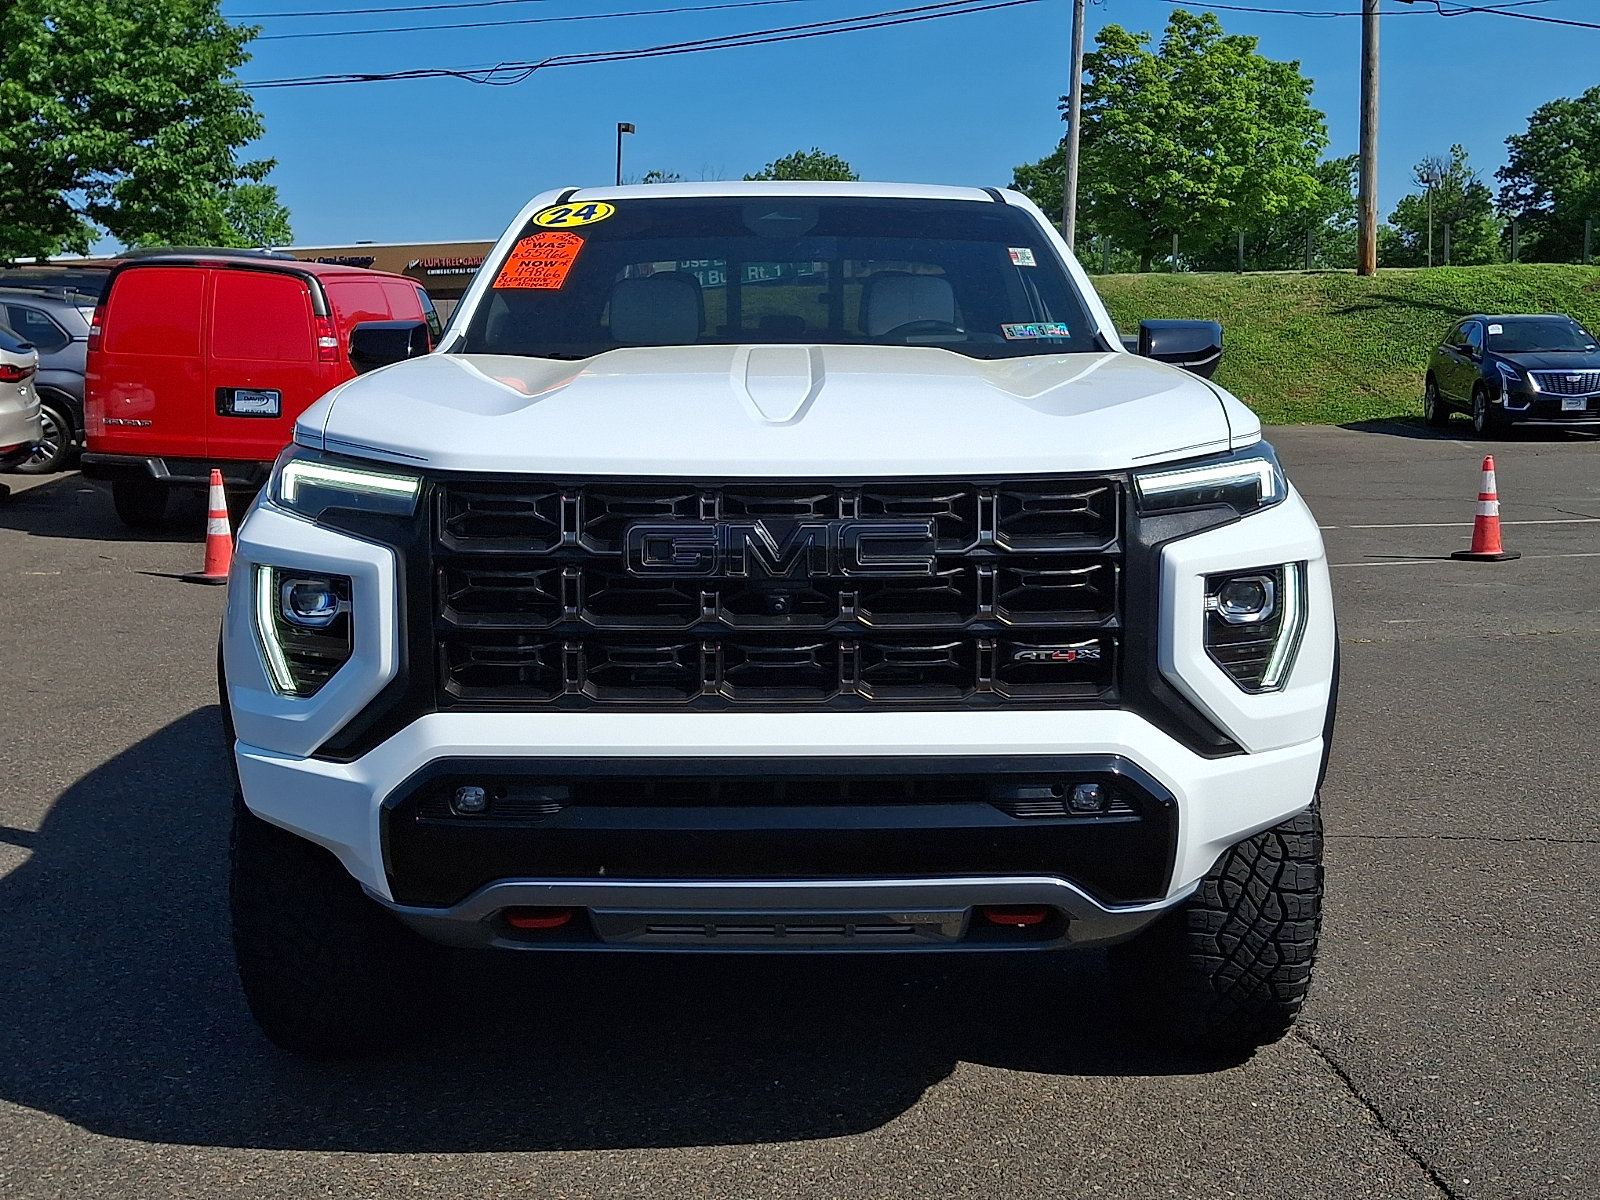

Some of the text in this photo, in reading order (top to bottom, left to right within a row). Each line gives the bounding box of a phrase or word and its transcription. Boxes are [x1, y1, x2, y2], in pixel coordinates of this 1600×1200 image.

[545, 204, 598, 225] 24
[419, 257, 440, 268] PLUM
[440, 257, 460, 267] TREE
[462, 256, 485, 266] GARD
[708, 270, 727, 284] Bu
[747, 265, 769, 280] Rt.
[623, 518, 936, 578] GMC
[1013, 649, 1101, 662] AT4X
